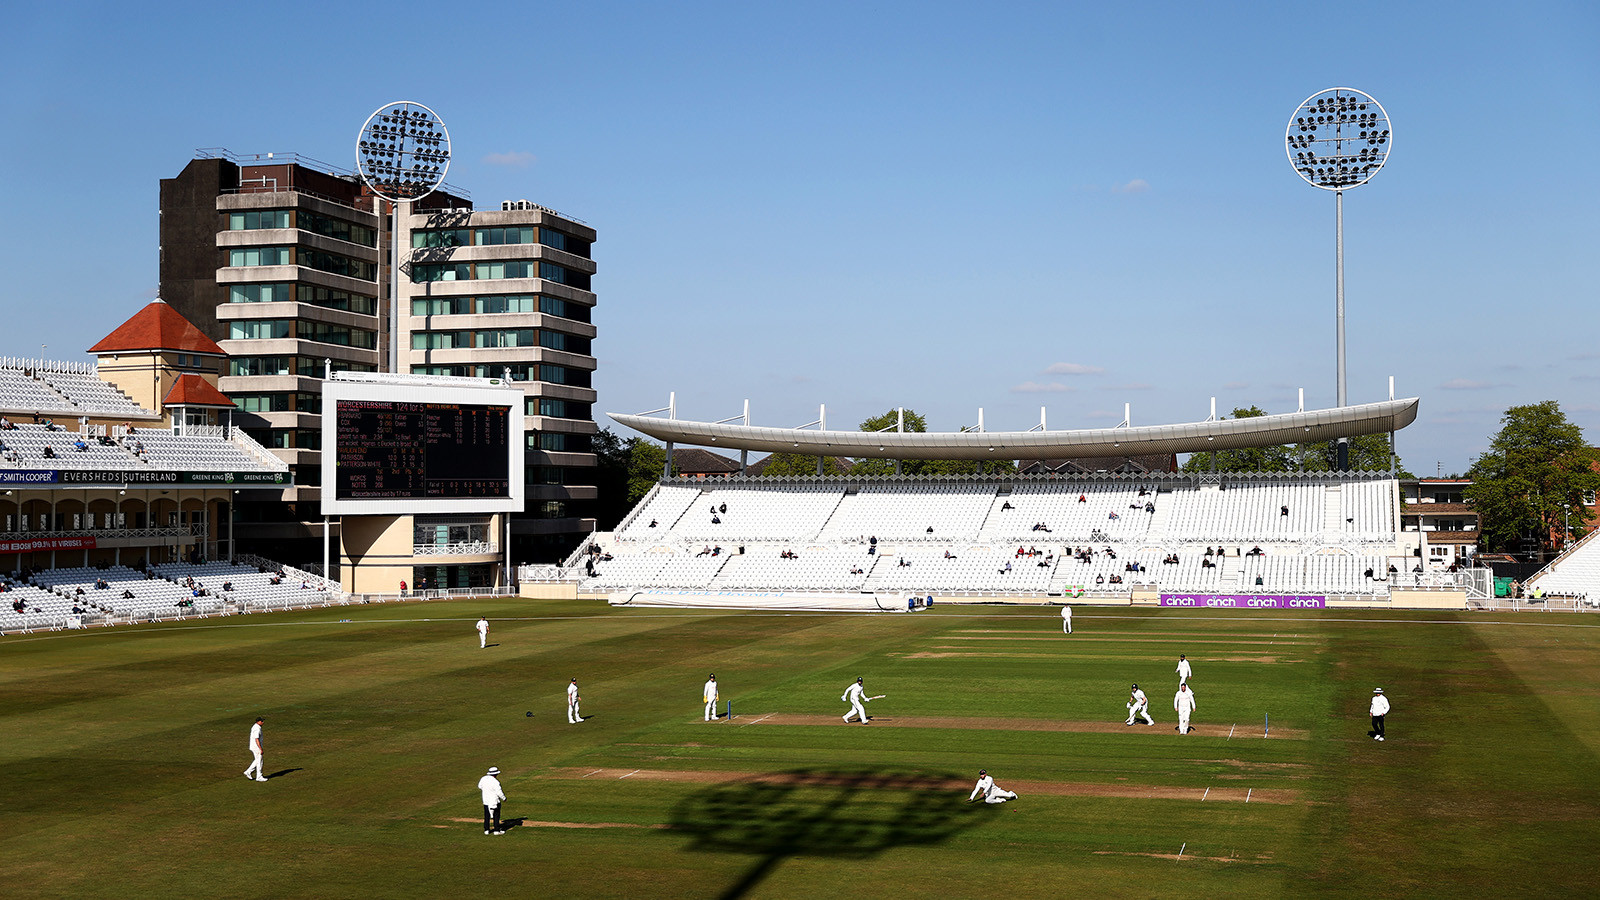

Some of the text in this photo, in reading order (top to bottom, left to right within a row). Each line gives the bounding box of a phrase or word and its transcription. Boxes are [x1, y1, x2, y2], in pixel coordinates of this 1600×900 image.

[337, 401, 393, 409] WORCESTERSHIRE
[397, 403, 408, 411] 124
[420, 404, 424, 412] 5
[3, 473, 25, 481] SMITH
[25, 473, 51, 481] COOPER
[64, 472, 176, 481] EVERSHEDS SUTHERLAND
[224, 473, 234, 481] IPA
[274, 473, 283, 481] IPA
[1166, 595, 1319, 608] cinch cinch cinch cinch
